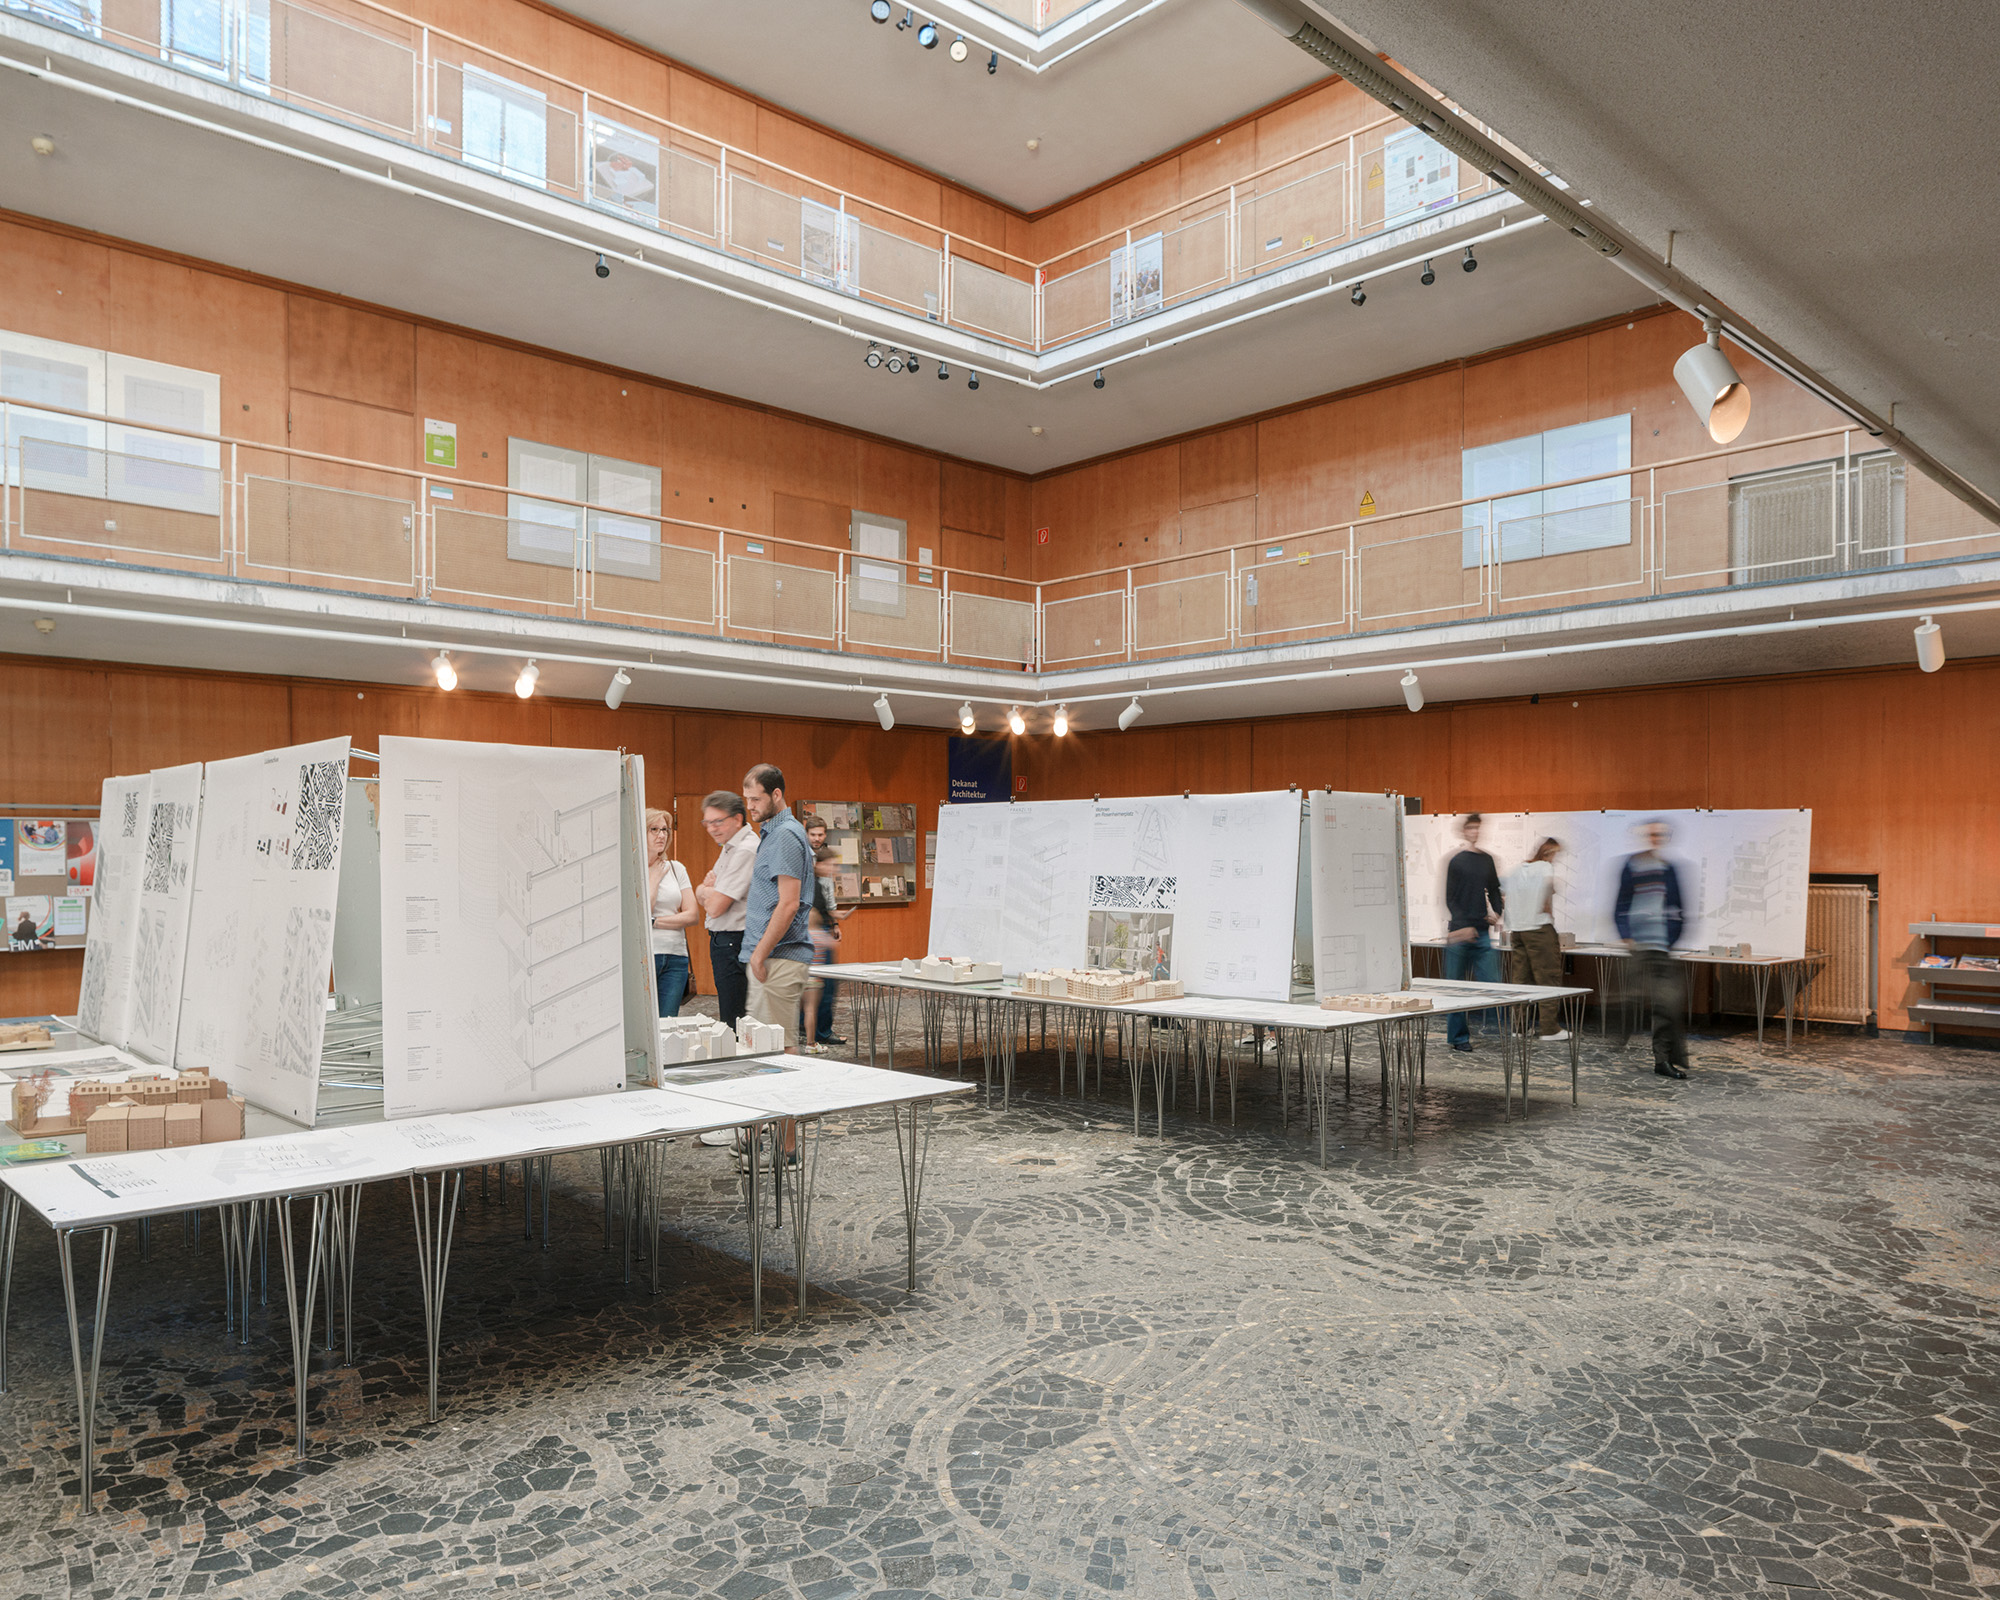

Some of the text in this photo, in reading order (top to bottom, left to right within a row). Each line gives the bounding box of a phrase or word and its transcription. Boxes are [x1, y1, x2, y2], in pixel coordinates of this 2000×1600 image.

[952, 779, 978, 788] Dekanat
[952, 790, 987, 799] Architektur
[10, 940, 35, 951] HM
